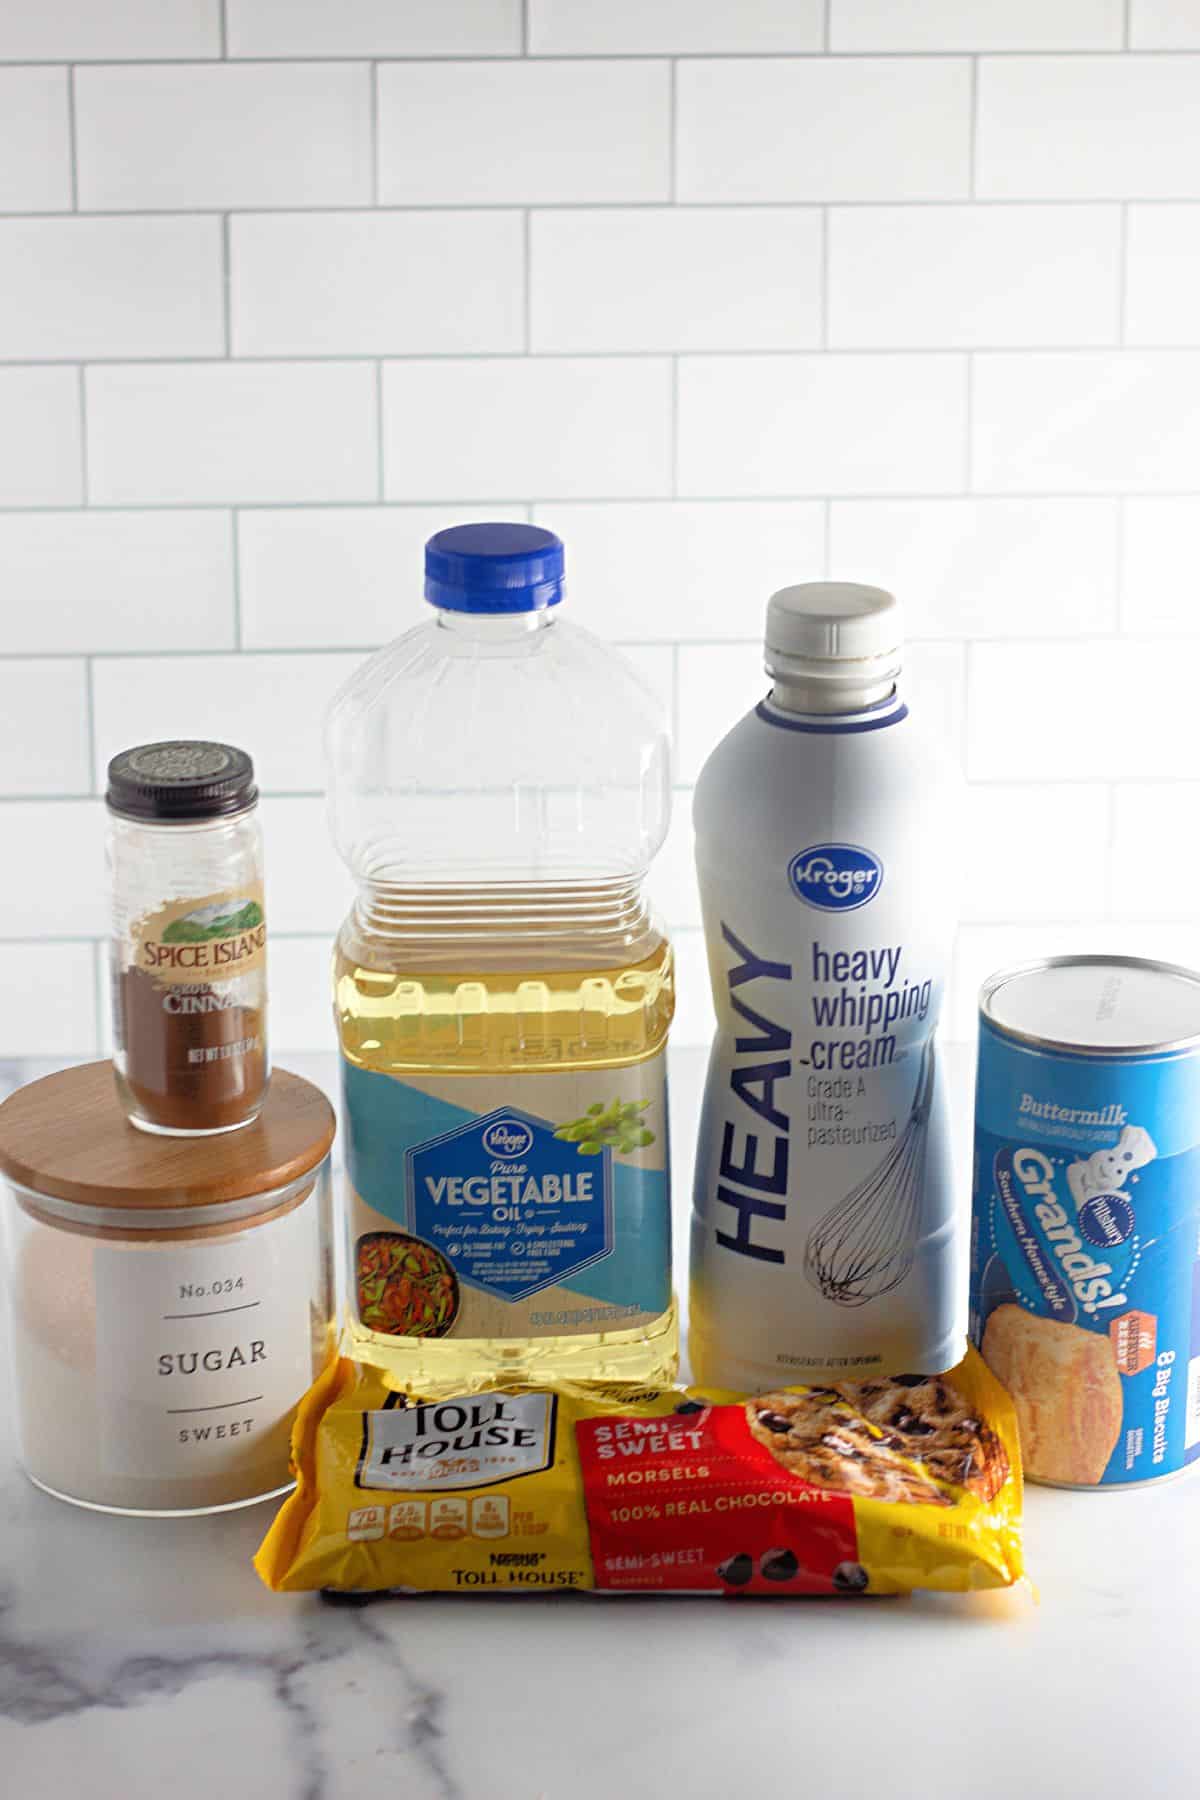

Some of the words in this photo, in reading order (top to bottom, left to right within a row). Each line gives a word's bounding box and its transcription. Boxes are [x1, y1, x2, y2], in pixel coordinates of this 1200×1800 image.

[796, 858, 877, 897] Kroger
[144, 942, 208, 968] SPICE
[213, 926, 265, 965] ISLAN
[812, 942, 902, 988] heavy
[812, 978, 932, 1034] whipping
[810, 1034, 897, 1070] cream
[716, 920, 792, 1264] HEAVY
[808, 1076, 852, 1098] Grade
[857, 1076, 866, 1096] A
[1020, 1093, 1128, 1125] Buttermilk
[490, 1126, 527, 1152] Kroger
[808, 1119, 896, 1151] pasteurized
[490, 1160, 528, 1175] Pure
[424, 1172, 593, 1206] VEGETABLE
[492, 1207, 520, 1221] OIL
[1090, 1198, 1124, 1246] Pillsbury
[998, 1170, 1027, 1236] Southern
[1021, 1237, 1065, 1310] Homestyle
[1013, 1148, 1127, 1313] Grands!
[180, 1277, 244, 1299] No.034
[158, 1340, 267, 1376] SUGAR
[1157, 1350, 1175, 1366] 8
[1152, 1368, 1171, 1397] Big
[179, 1418, 254, 1444] SWEET
[404, 1402, 516, 1436] TOLL
[594, 1422, 684, 1442] SEMI-
[1152, 1398, 1170, 1464] Biscuits
[380, 1426, 536, 1464] HOUSE
[597, 1431, 704, 1459] SWEET
[607, 1466, 710, 1486] MORSELS
[611, 1505, 660, 1522] 100%
[665, 1500, 712, 1517] REAL
[715, 1490, 833, 1511] CHOCOLATE
[605, 1548, 705, 1571] SEMI-SWEET
[452, 1569, 505, 1585] TOLL
[508, 1571, 578, 1585] HOUSE
